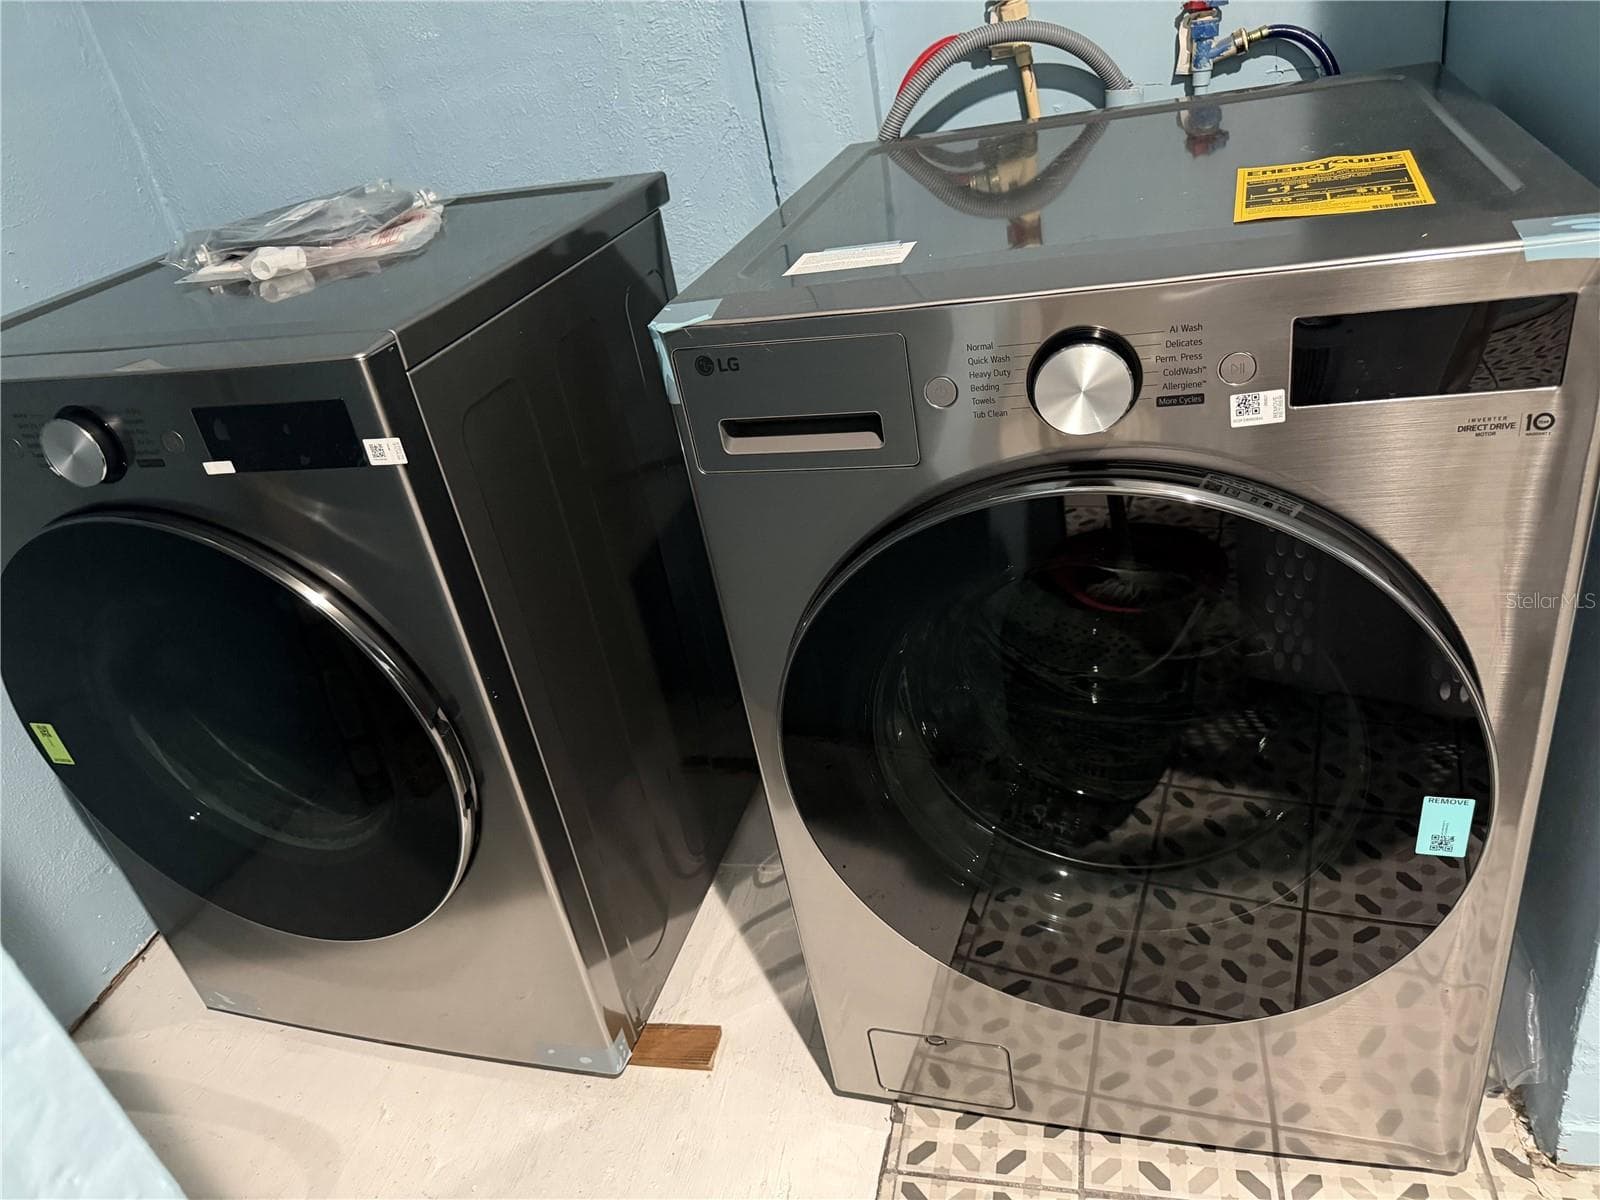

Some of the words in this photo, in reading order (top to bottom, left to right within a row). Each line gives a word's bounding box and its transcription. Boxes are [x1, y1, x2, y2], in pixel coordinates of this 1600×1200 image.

[1181, 322, 1203, 332] Wash
[966, 342, 994, 352] Normal
[1166, 339, 1203, 348] Delicates
[968, 356, 988, 366] Quick
[990, 354, 1010, 364] Wash
[1156, 355, 1176, 363] Perm.
[717, 357, 740, 372] LG
[968, 371, 992, 380] Heavy
[994, 369, 1011, 378] Duty
[970, 384, 1000, 392] Bedding
[972, 397, 996, 405] Towels
[1158, 397, 1178, 405] More
[1180, 394, 1202, 404] Cycles
[1526, 412, 1556, 432] 10
[1457, 424, 1488, 433] DIRECT
[1489, 422, 1517, 430] DRIVE
[1428, 798, 1470, 806] REMOVE
